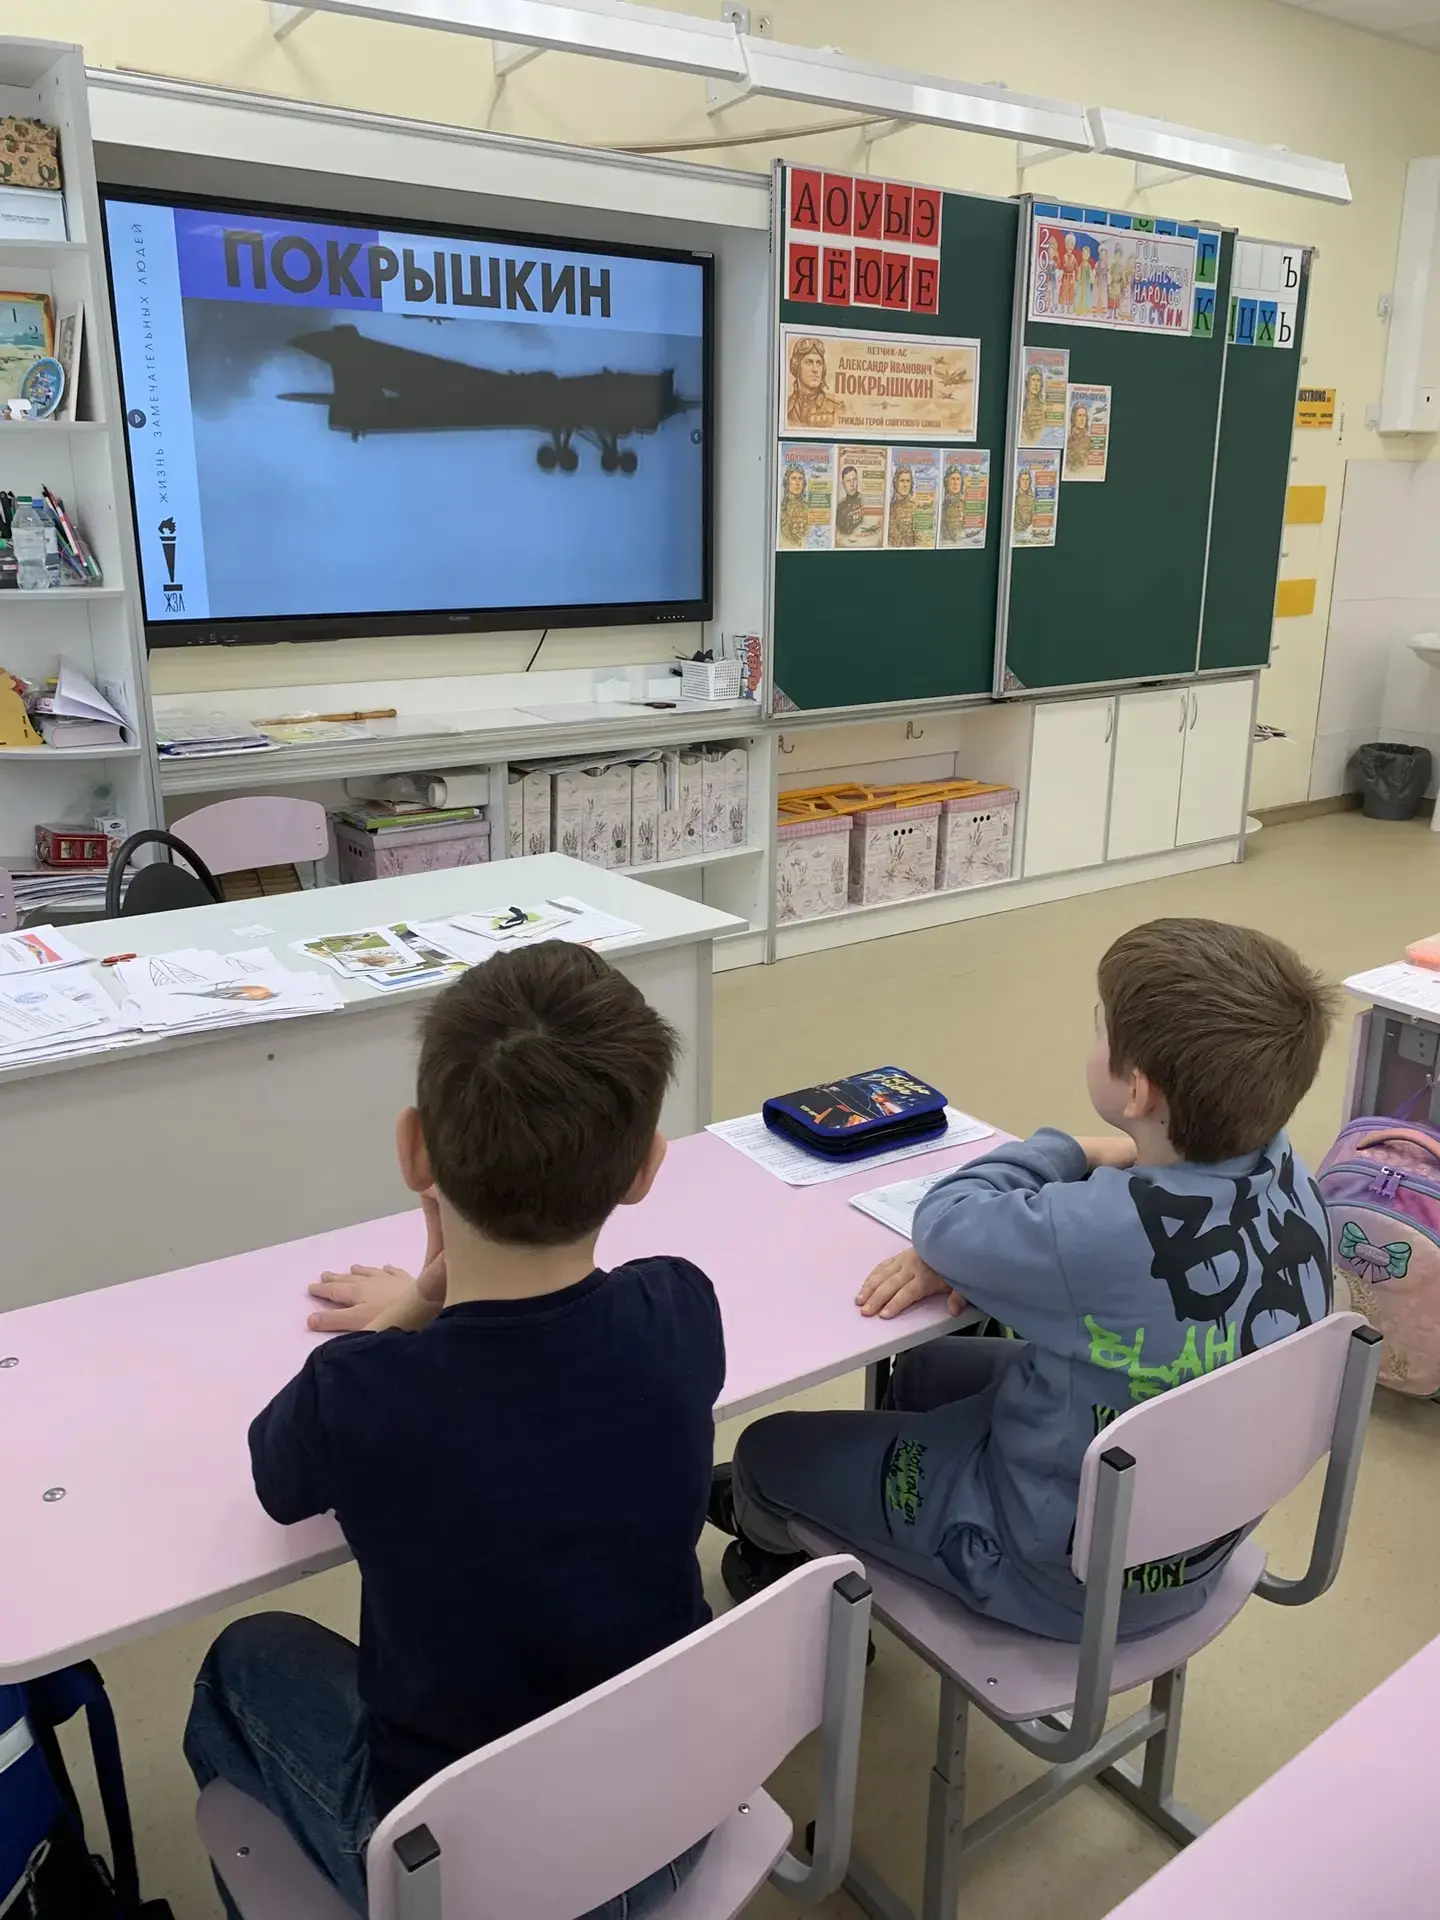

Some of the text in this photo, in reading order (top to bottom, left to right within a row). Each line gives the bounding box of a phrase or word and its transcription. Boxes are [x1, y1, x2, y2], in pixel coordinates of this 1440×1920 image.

[1135, 240, 1159, 263] ГОД
[223, 229, 611, 318] ПОКРЫШКИН
[1036, 228, 1050, 314] 2026
[1134, 262, 1188, 287] ЕДИНСТВА
[1133, 284, 1182, 307] НАРОДОВ
[1131, 304, 1183, 328] РОССИИ
[131, 223, 168, 503] ЖИЗНЬ ЗАМЕЧАТЕЛЬНЫХ ЛЮДЕЙ
[866, 346, 908, 357] ЛЕТЧИК-АС
[835, 372, 934, 399] ПОКРЫШКИН
[164, 592, 186, 613] ЖЗЛ
